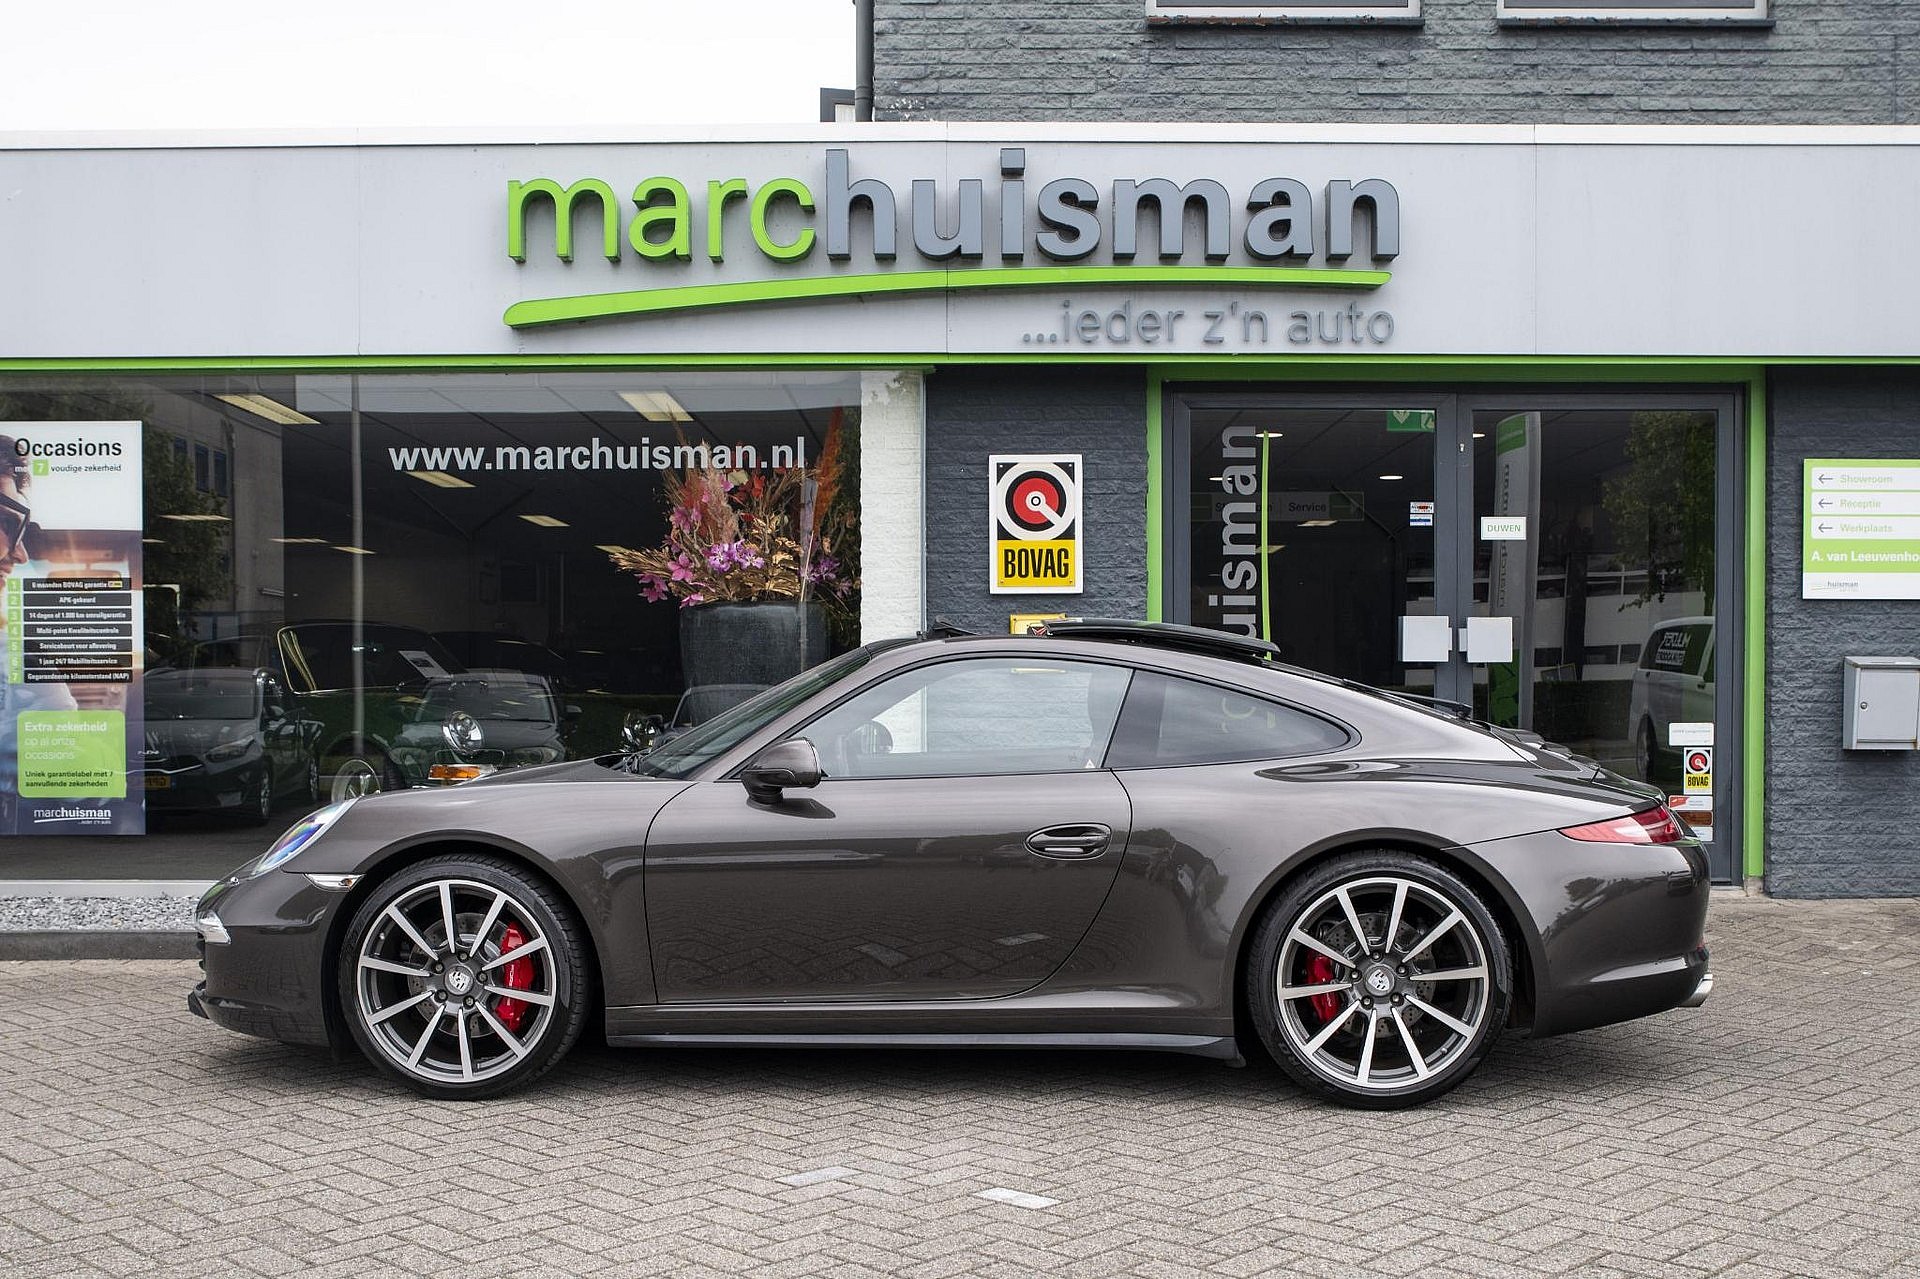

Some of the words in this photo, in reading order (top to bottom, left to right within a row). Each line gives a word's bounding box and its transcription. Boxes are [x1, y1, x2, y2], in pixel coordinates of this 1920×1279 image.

[507, 149, 1400, 262] marchuisman
[1204, 300, 1269, 344] z'n
[1287, 301, 1395, 344] auto
[14, 438, 122, 457] Occasions
[388, 436, 806, 470] www.marchuisman.nl
[51, 463, 81, 474] voudige
[84, 463, 122, 473] zekerheid
[1839, 474, 1893, 484] Showroom
[1288, 502, 1327, 513] Service
[1839, 499, 1881, 510] Receptie
[1487, 524, 1521, 533] DUWEN
[1839, 524, 1894, 534] Werkplaats
[1811, 551, 1824, 562] A.
[1827, 553, 1848, 562] van
[1003, 548, 1070, 579] BOVAG
[24, 721, 52, 732] Extra
[55, 721, 108, 732] zekerheid
[24, 750, 75, 760] occasions
[24, 770, 45, 778] Uniek
[1687, 774, 1709, 787] BOVAG
[33, 806, 112, 818] marchuisman
